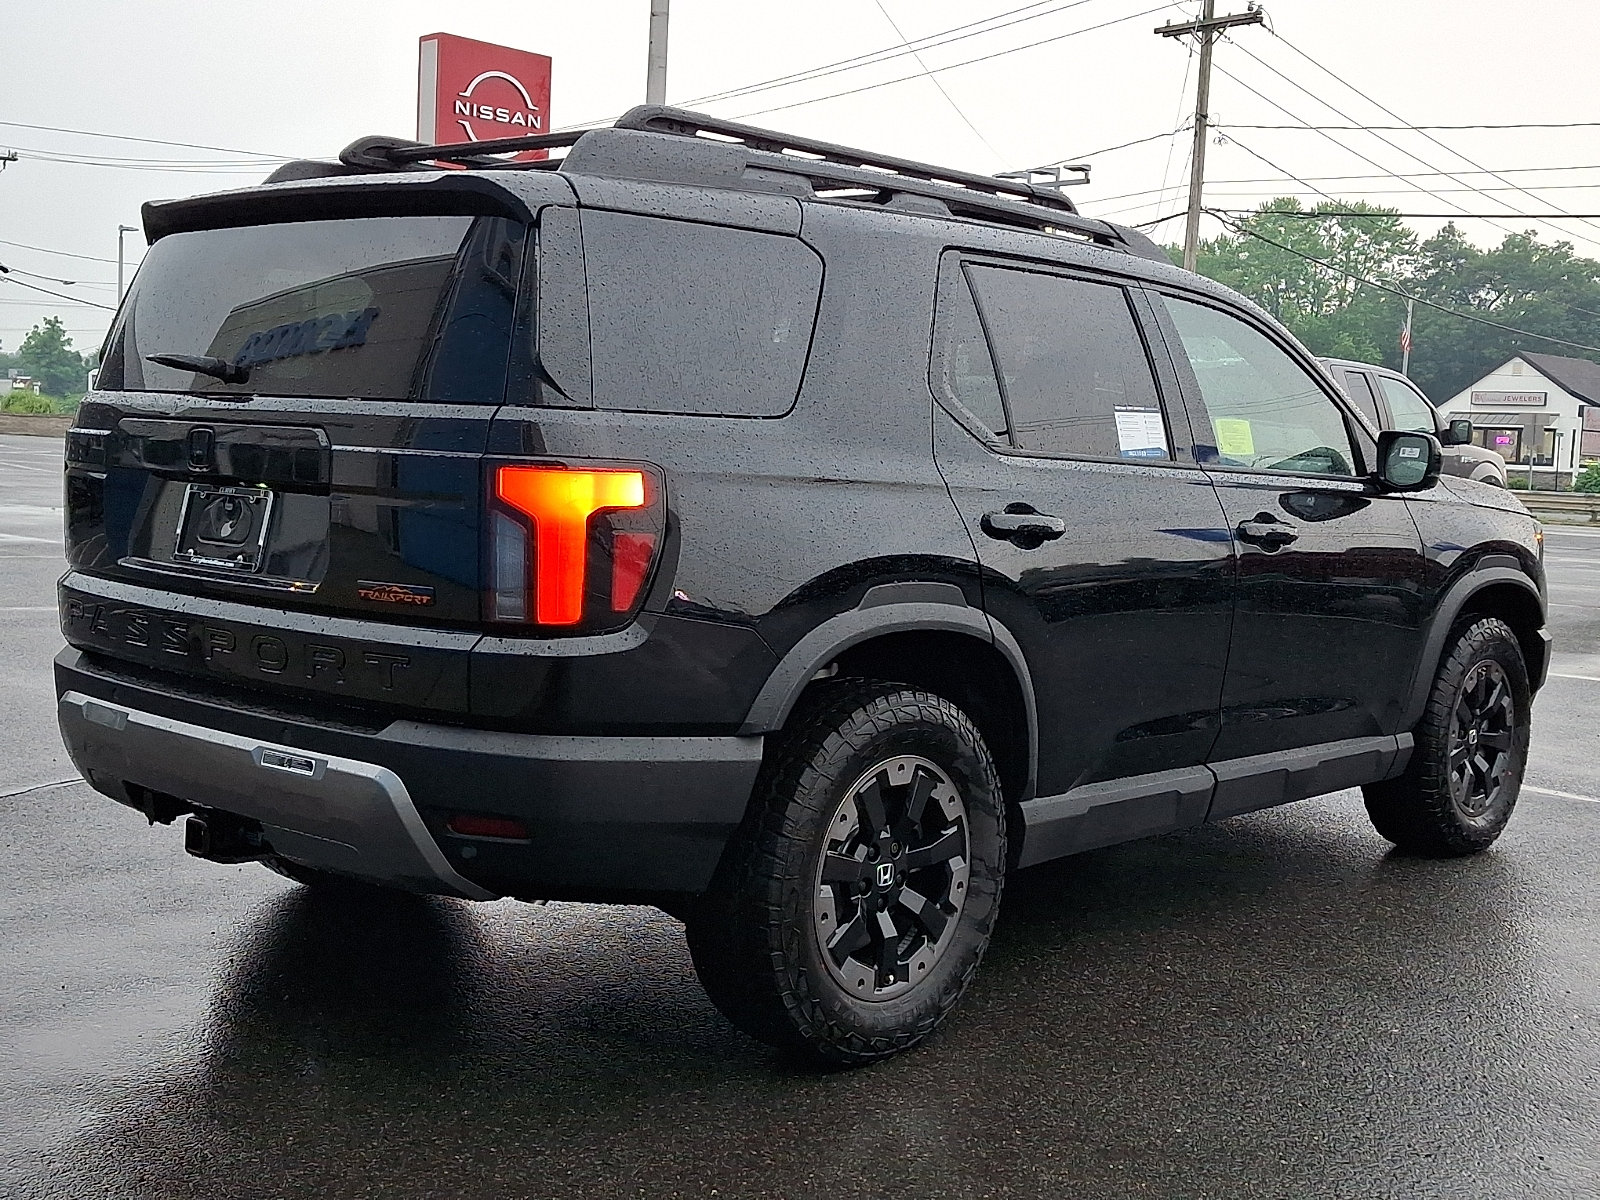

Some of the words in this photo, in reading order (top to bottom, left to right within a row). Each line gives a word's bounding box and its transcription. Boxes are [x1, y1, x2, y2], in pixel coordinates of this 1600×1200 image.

[455, 100, 541, 129] NISSAN
[1503, 395, 1542, 403] JEWELERS
[358, 589, 431, 604] TRAILSPORT
[67, 598, 411, 690] PASSPORT
